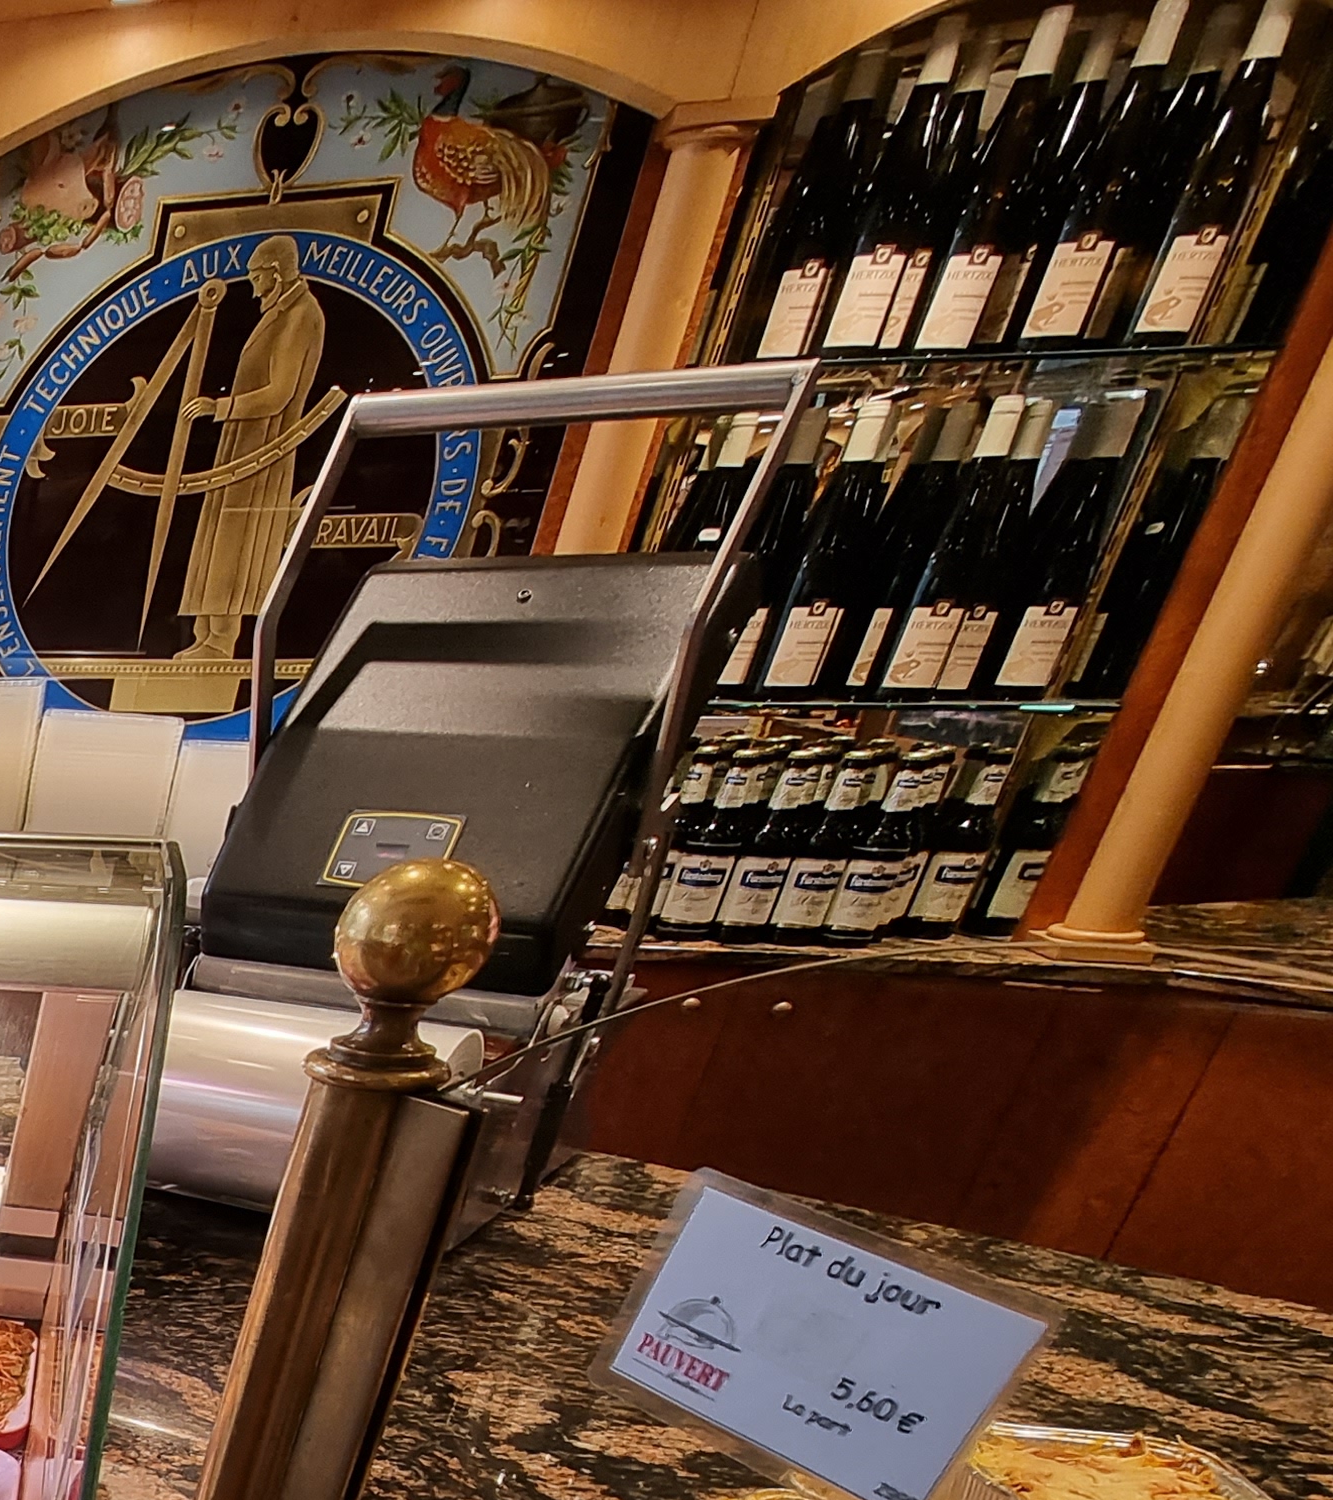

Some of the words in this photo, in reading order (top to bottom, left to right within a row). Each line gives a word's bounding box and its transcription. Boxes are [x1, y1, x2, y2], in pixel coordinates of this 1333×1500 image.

[23, 278, 157, 415] TECHNIQUE
[181, 243, 243, 289] AUX
[301, 241, 429, 325] MEILLEURS
[435, 478, 468, 515] DE
[51, 406, 119, 435] JOIE
[315, 516, 402, 545] RAVAIL
[758, 1225, 823, 1268] Plat
[826, 1255, 867, 1288] du
[863, 1272, 942, 1315] jour
[636, 1331, 731, 1393] PAUVERT
[804, 1410, 853, 1437] part
